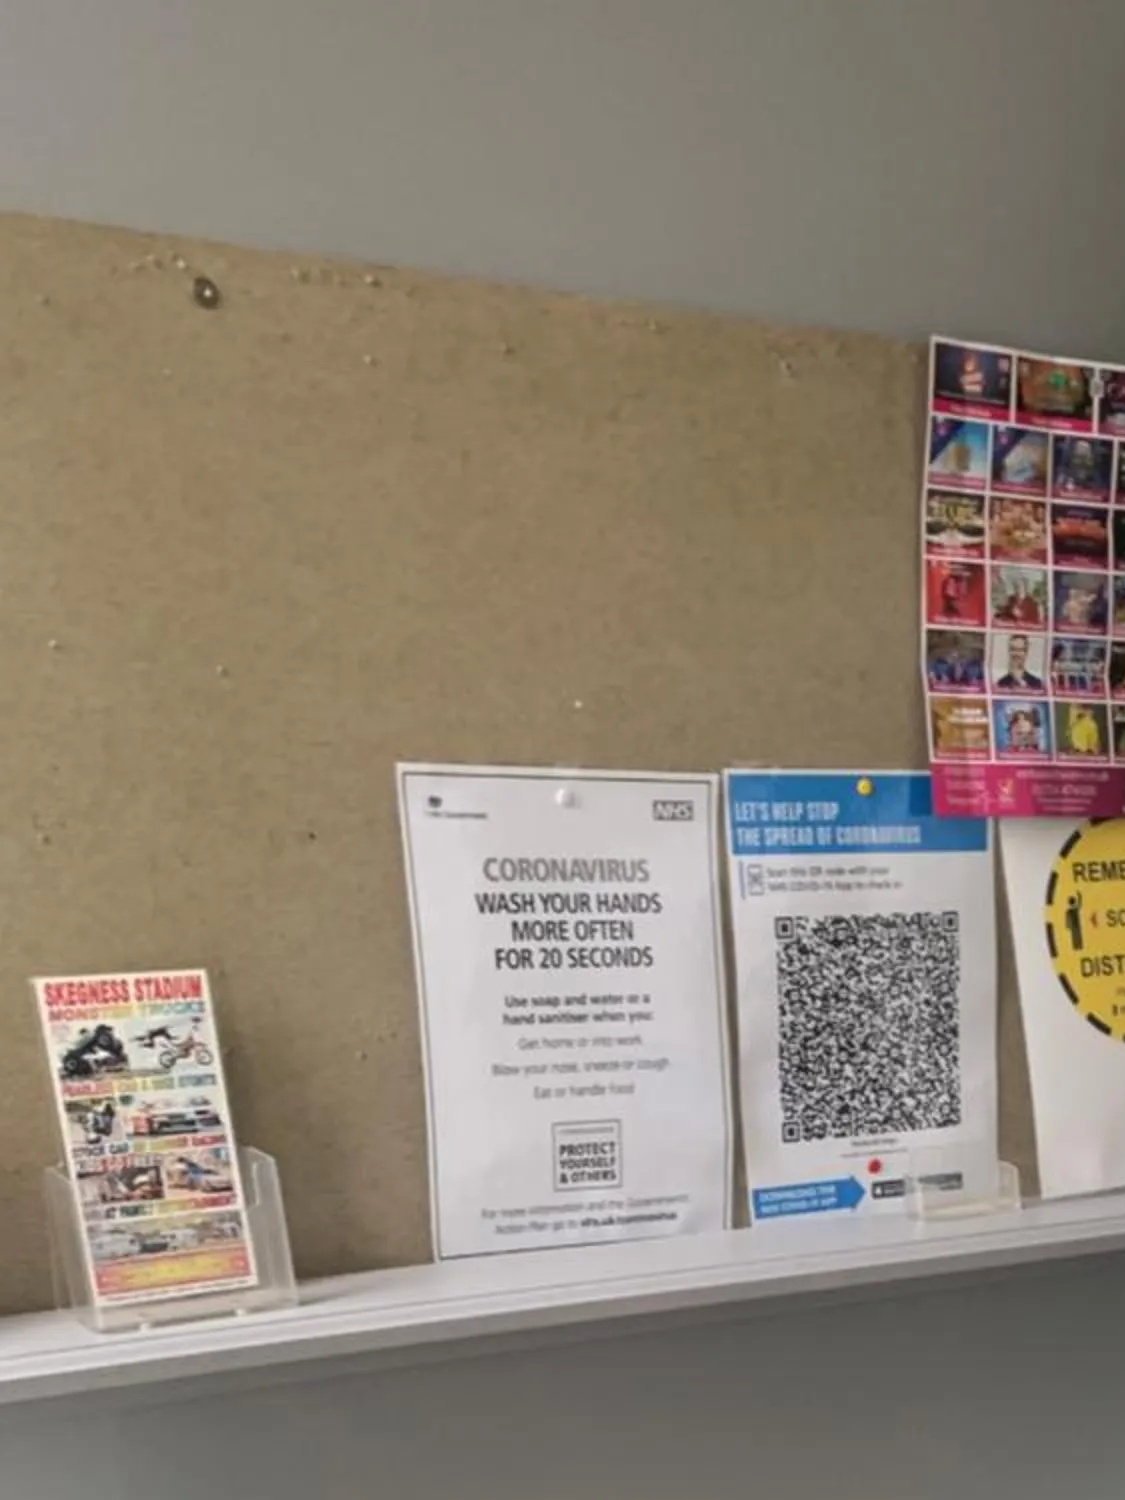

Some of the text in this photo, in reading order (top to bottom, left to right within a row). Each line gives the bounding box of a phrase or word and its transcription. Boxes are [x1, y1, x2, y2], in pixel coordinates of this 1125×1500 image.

[654, 801, 693, 820] NHS
[736, 827, 761, 846] THE
[763, 826, 813, 846] SPREAD
[816, 826, 832, 845] OF
[482, 857, 651, 883] CORONAVIRUS
[475, 892, 663, 914] WASH YOUR HANDS
[512, 920, 634, 942] MORE OFTEN
[495, 946, 654, 970] FOR 20 SECONDS
[44, 976, 203, 1006] SKEGNESS STADIUM
[504, 995, 528, 1008] Use
[531, 995, 560, 1009] soap
[564, 993, 587, 1006] and
[503, 1013, 536, 1025] hand
[558, 1141, 617, 1157] PROTECT
[559, 1155, 617, 1170] YOURSELF
[559, 1169, 617, 1184] & OTHERS
